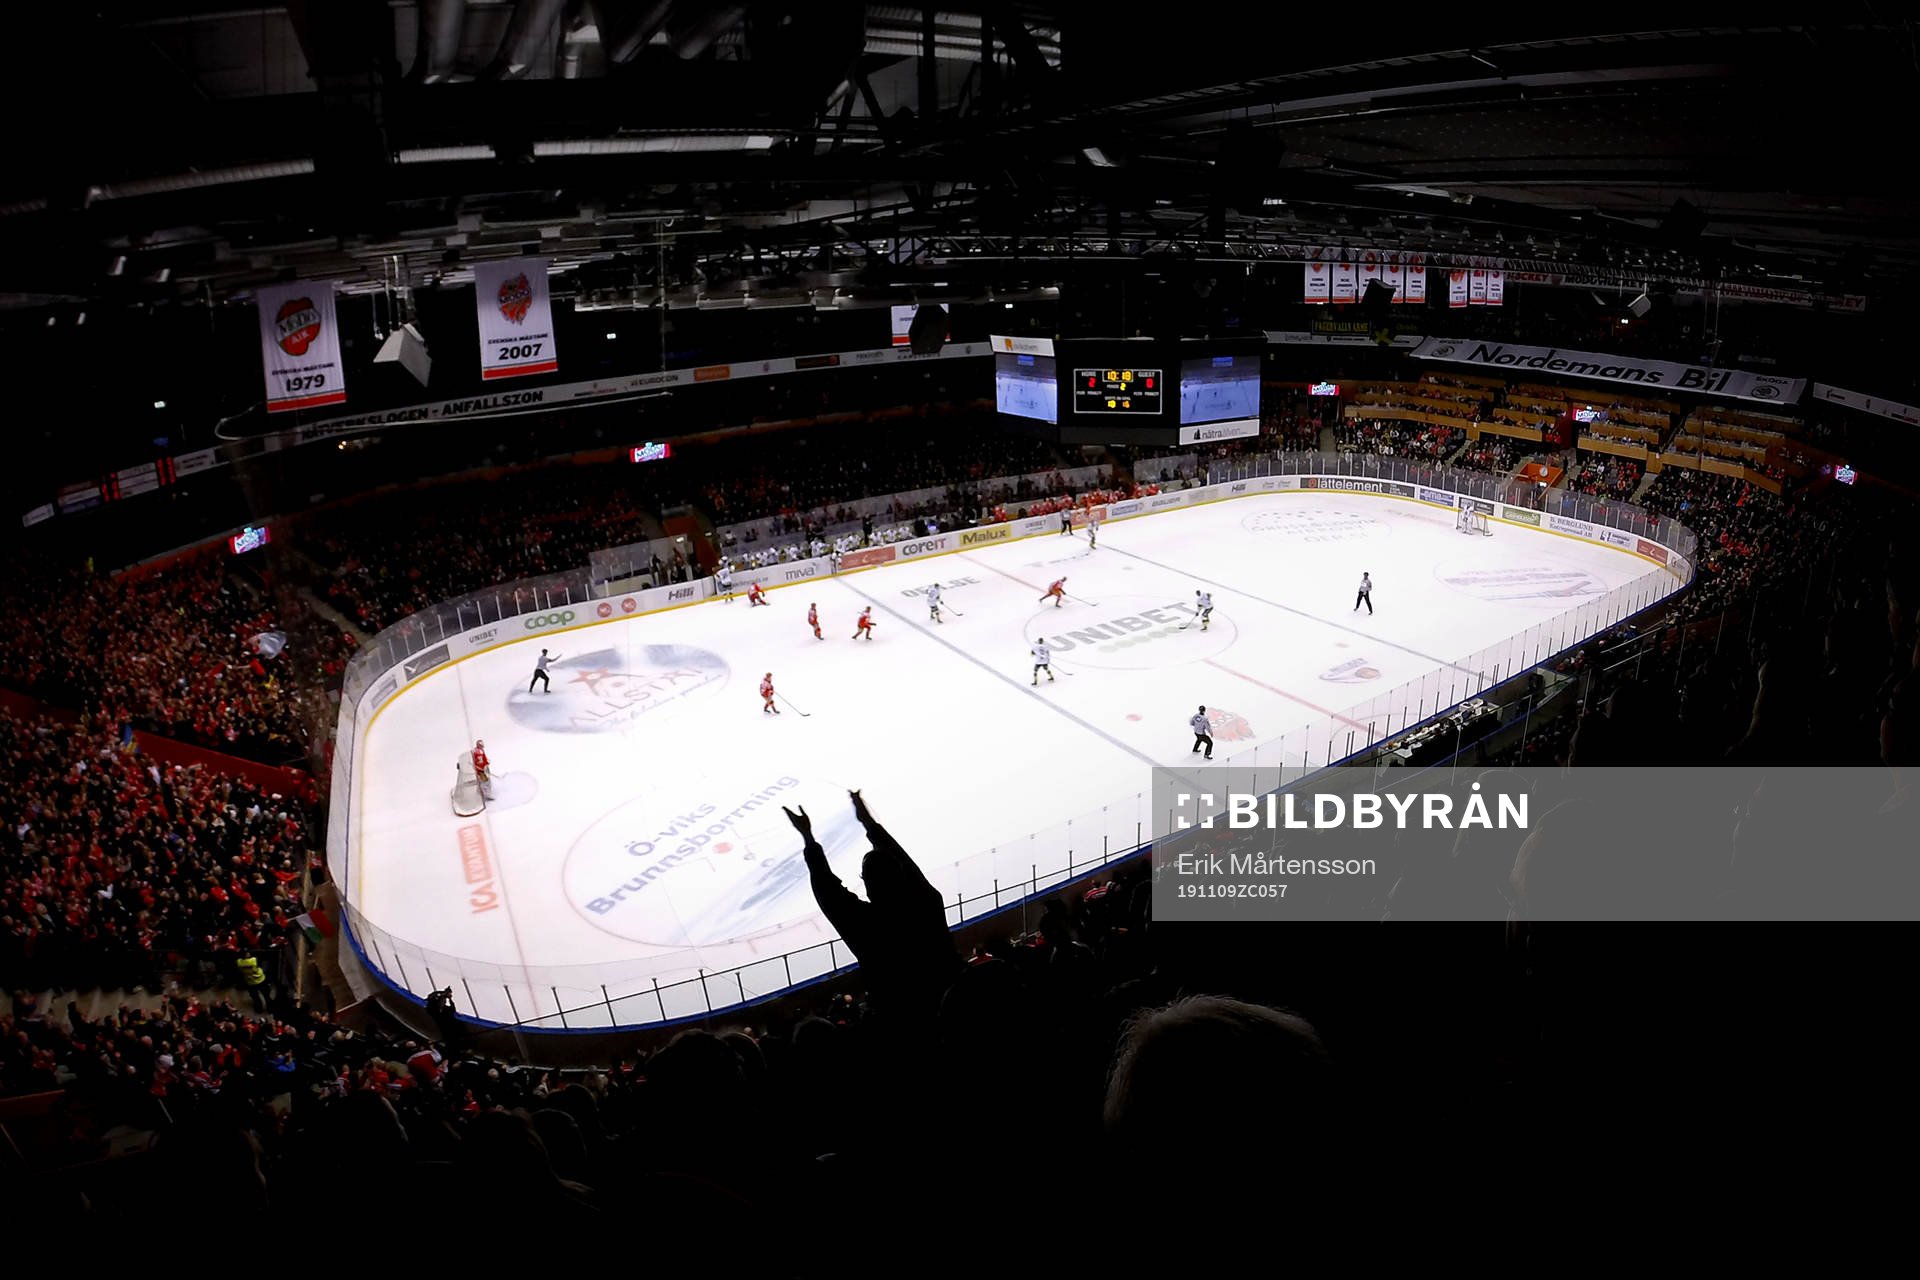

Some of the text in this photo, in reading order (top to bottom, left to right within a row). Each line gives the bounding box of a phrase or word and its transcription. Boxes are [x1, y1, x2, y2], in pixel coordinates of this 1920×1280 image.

[499, 343, 542, 360] 2007
[1468, 344, 1731, 392] Nordemans Bil
[286, 373, 325, 392] 1979
[442, 390, 543, 415] ANFALLSZON
[1317, 478, 1383, 493] lättelement
[1557, 518, 1593, 531] BERGLUND
[962, 527, 1006, 544] Malux
[785, 565, 815, 581] miva
[668, 587, 695, 601] Hilli
[524, 610, 575, 631] coop
[1046, 602, 1197, 653] UNIBET
[468, 629, 498, 644] UNIBET
[624, 801, 719, 858] Ö-viks
[585, 773, 801, 917] Brunnsborrning
[470, 881, 500, 915] ICA
